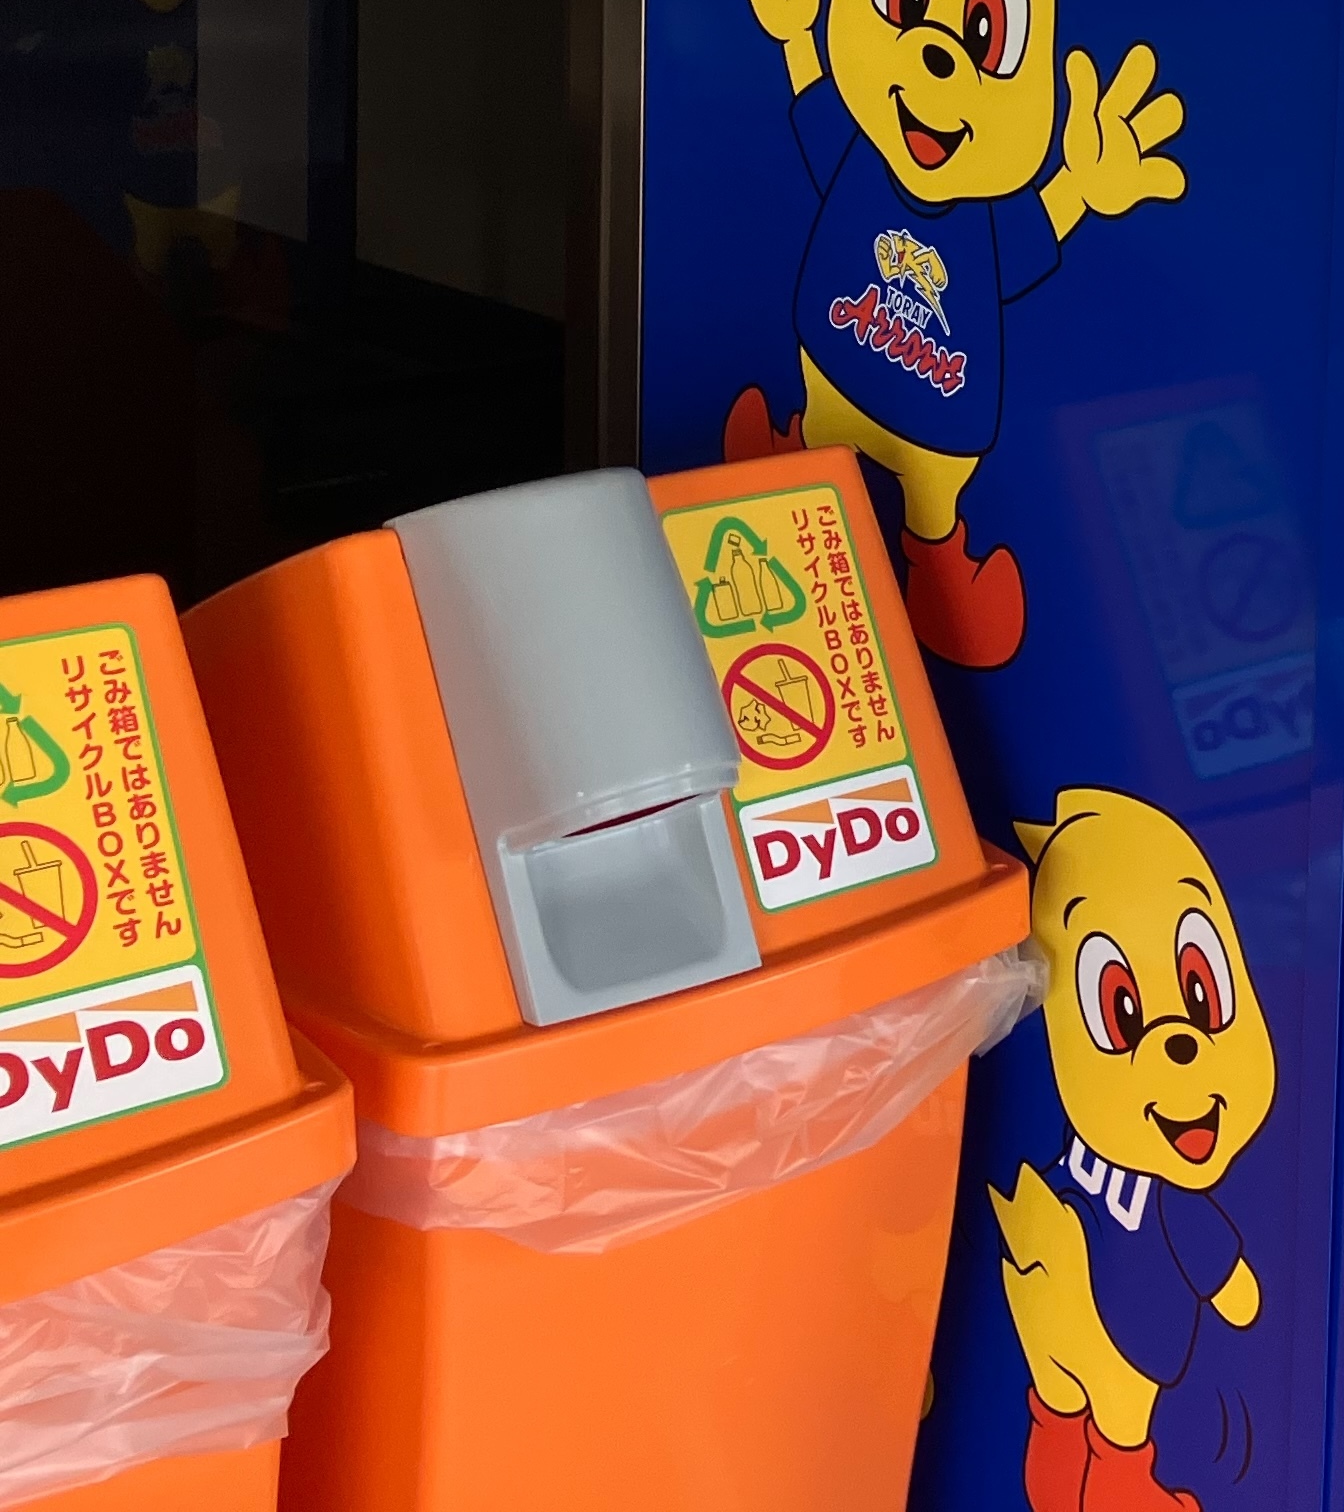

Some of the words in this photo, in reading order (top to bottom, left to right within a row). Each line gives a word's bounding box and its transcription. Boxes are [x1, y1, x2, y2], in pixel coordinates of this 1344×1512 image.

[828, 283, 969, 398] Arrows
[885, 286, 932, 330] TORAY
[789, 507, 870, 750] リサイクルBOXです
[814, 502, 895, 744] ごみ箱ではありません
[61, 656, 140, 949] リサイクルBOXです
[97, 647, 183, 939] ごみ箱ではありません
[752, 805, 921, 885] DyDo
